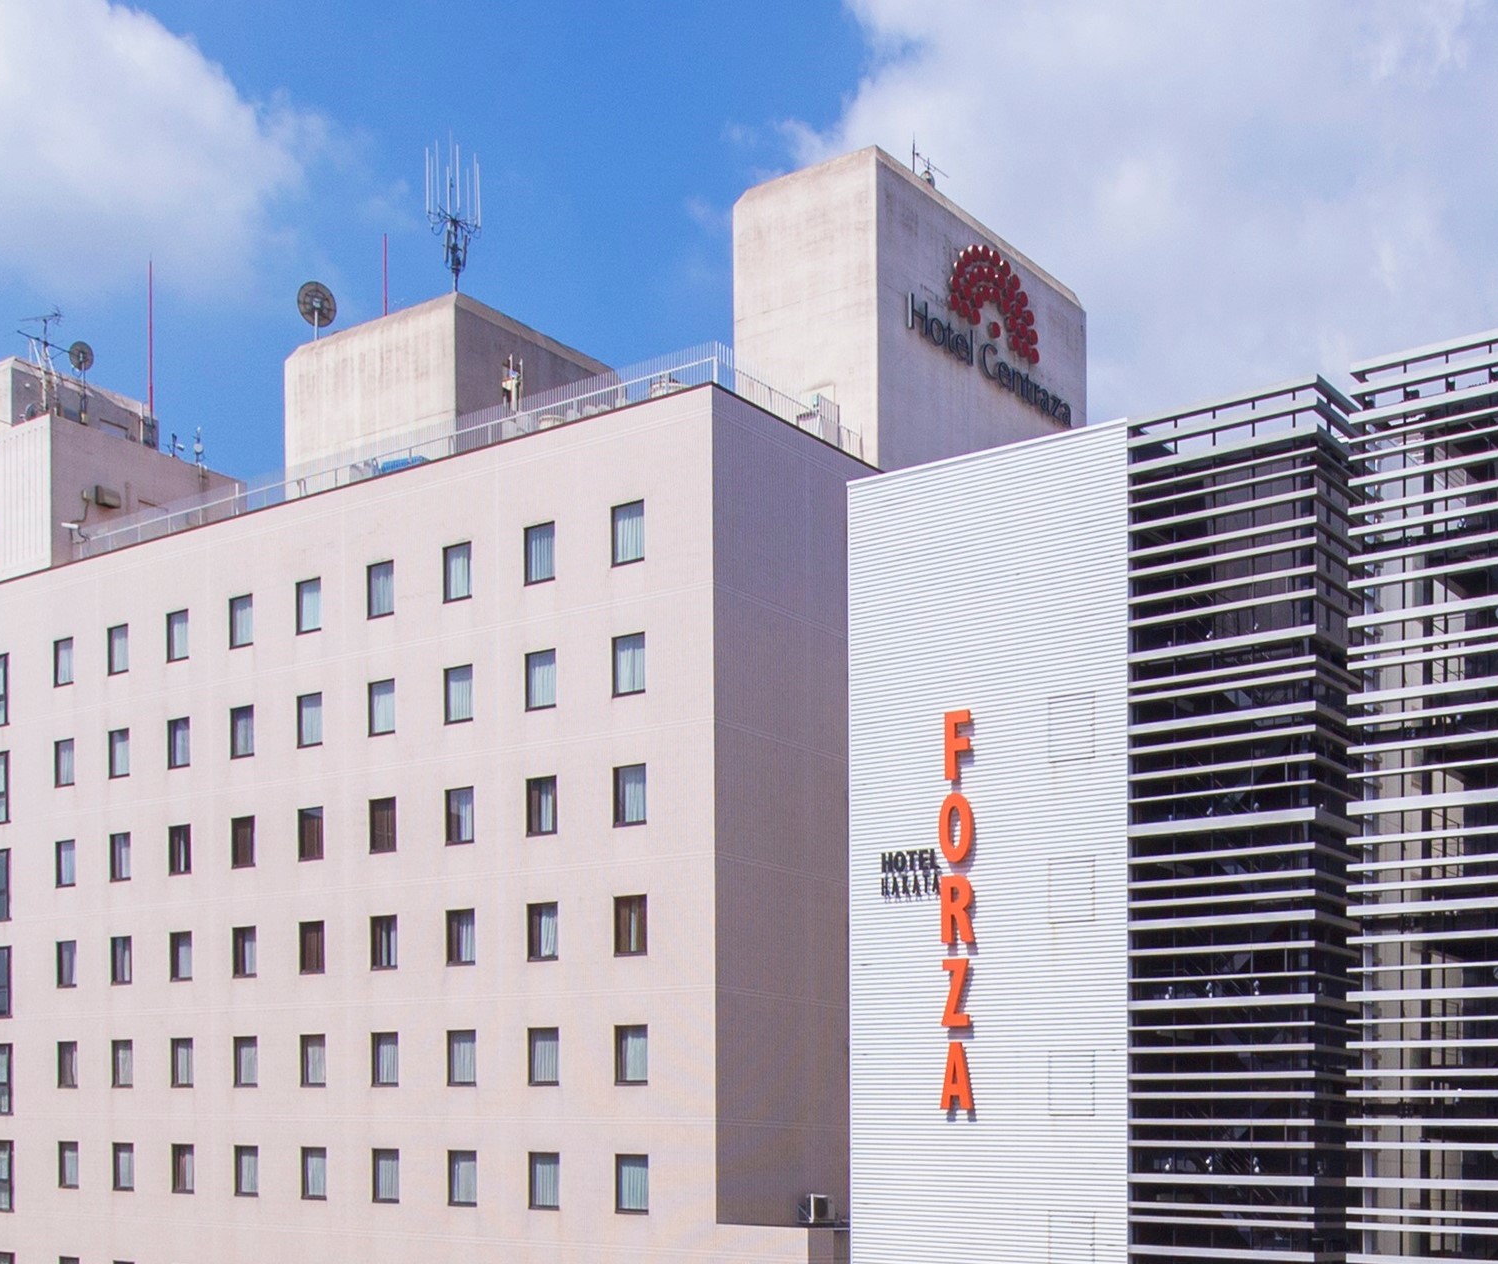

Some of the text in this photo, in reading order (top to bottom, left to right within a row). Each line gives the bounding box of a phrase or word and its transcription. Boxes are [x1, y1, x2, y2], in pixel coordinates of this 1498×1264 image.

[907, 291, 1072, 427] Hotel Centraza
[880, 848, 941, 873] HOTEL
[880, 875, 941, 897] HAKATA
[938, 709, 976, 1111] FORZA
